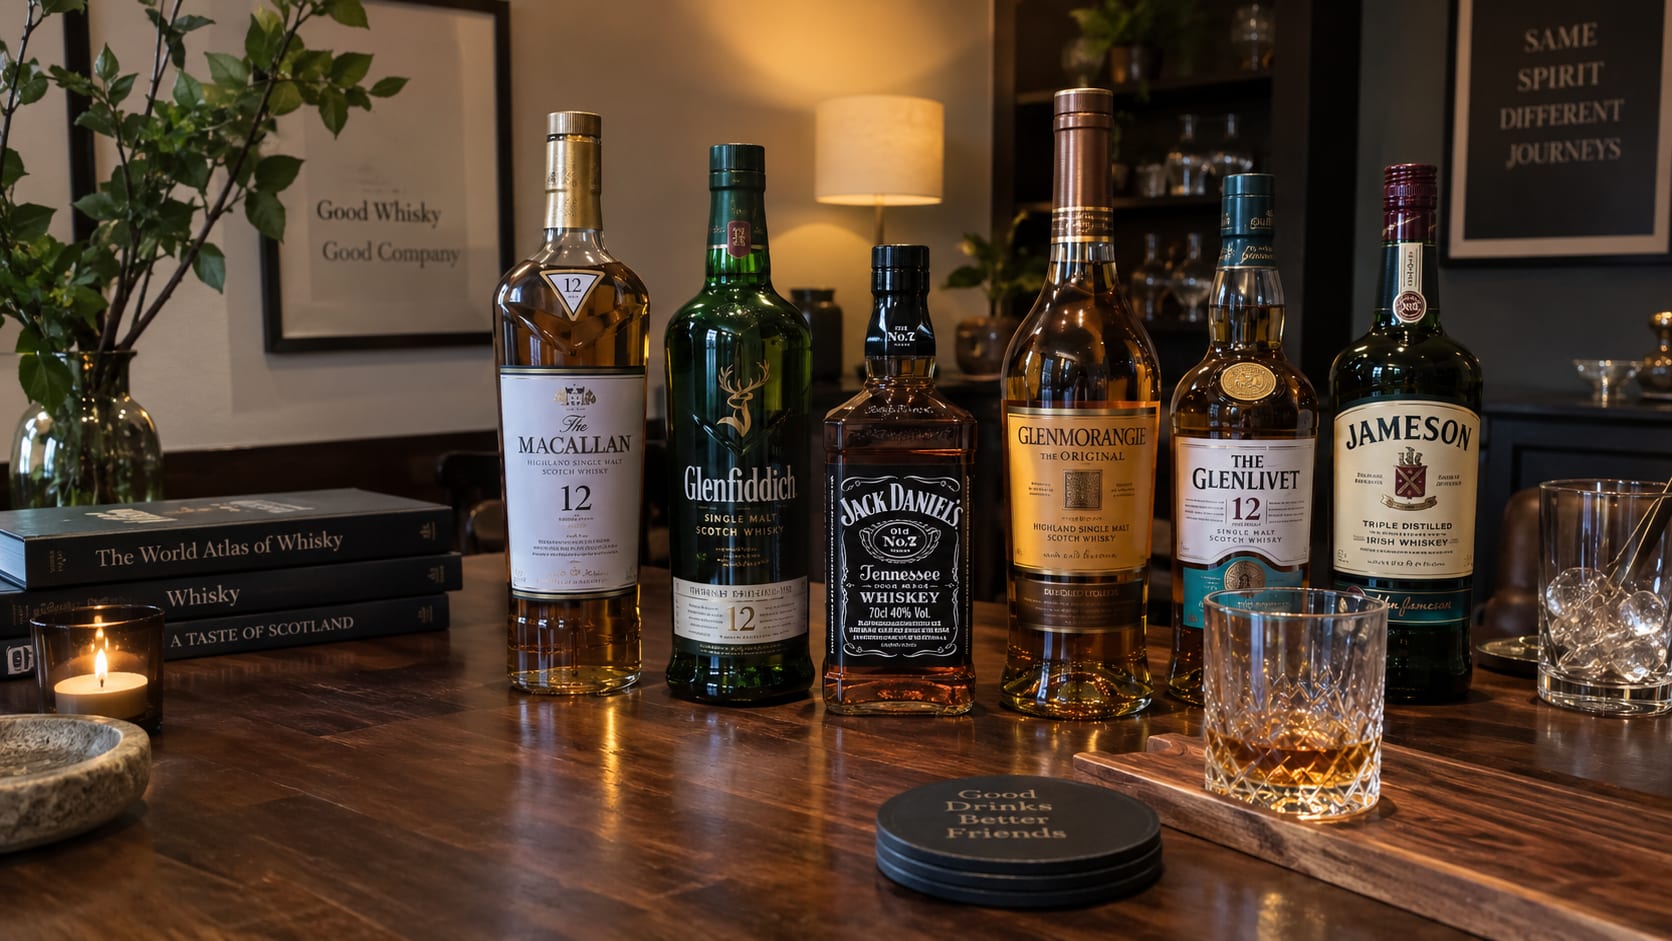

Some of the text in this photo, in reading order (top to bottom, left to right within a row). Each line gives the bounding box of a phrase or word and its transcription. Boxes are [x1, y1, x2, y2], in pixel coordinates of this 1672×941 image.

[1524, 22, 1598, 53] SAME
[1517, 61, 1604, 92] SPIRIT
[1500, 99, 1624, 130] DIFFERENT
[1506, 137, 1622, 169] JOURNEYS
[316, 200, 442, 229] Good Whisky
[322, 240, 460, 269] Good Company
[564, 277, 582, 293] 12
[560, 414, 589, 433] The
[1018, 425, 1146, 447] GLENMORANGIE
[1346, 415, 1472, 452] JAMESON
[518, 434, 632, 454] MACALLAN
[1041, 450, 1125, 461] THE ORIGINAL
[1231, 454, 1264, 469] THE
[684, 465, 796, 502] Glenfiddich
[1192, 468, 1300, 490] GLENLIVET
[561, 485, 592, 511] 12
[840, 490, 888, 526] JACK
[1231, 497, 1261, 521] 12
[704, 513, 777, 524] SINGLE MALT
[1033, 522, 1130, 534] HIGHLAND SINGLE MALT
[1362, 520, 1453, 530] TRIPLE DISTILLED
[695, 525, 784, 537] SCOTCH WHISKY
[890, 527, 909, 535] Old
[1047, 533, 1116, 543] SCOTCH WHISKY
[1209, 535, 1244, 543] SCOTCH
[96, 530, 344, 567] The World Atlas of Whisky
[1366, 536, 1449, 547] IRISH WHISKEY
[859, 564, 941, 581] Tennessee
[166, 584, 240, 608] Whisky
[859, 591, 940, 604] WHISKEY
[727, 606, 756, 632] 12
[869, 606, 931, 619] 70cl 40% Vol.
[170, 616, 354, 648] A TASTE OF SCOTLAND
[958, 789, 1038, 799] Good
[945, 800, 1053, 812] Drinks
[959, 814, 1049, 825] Better
[946, 827, 1067, 840] Friends
